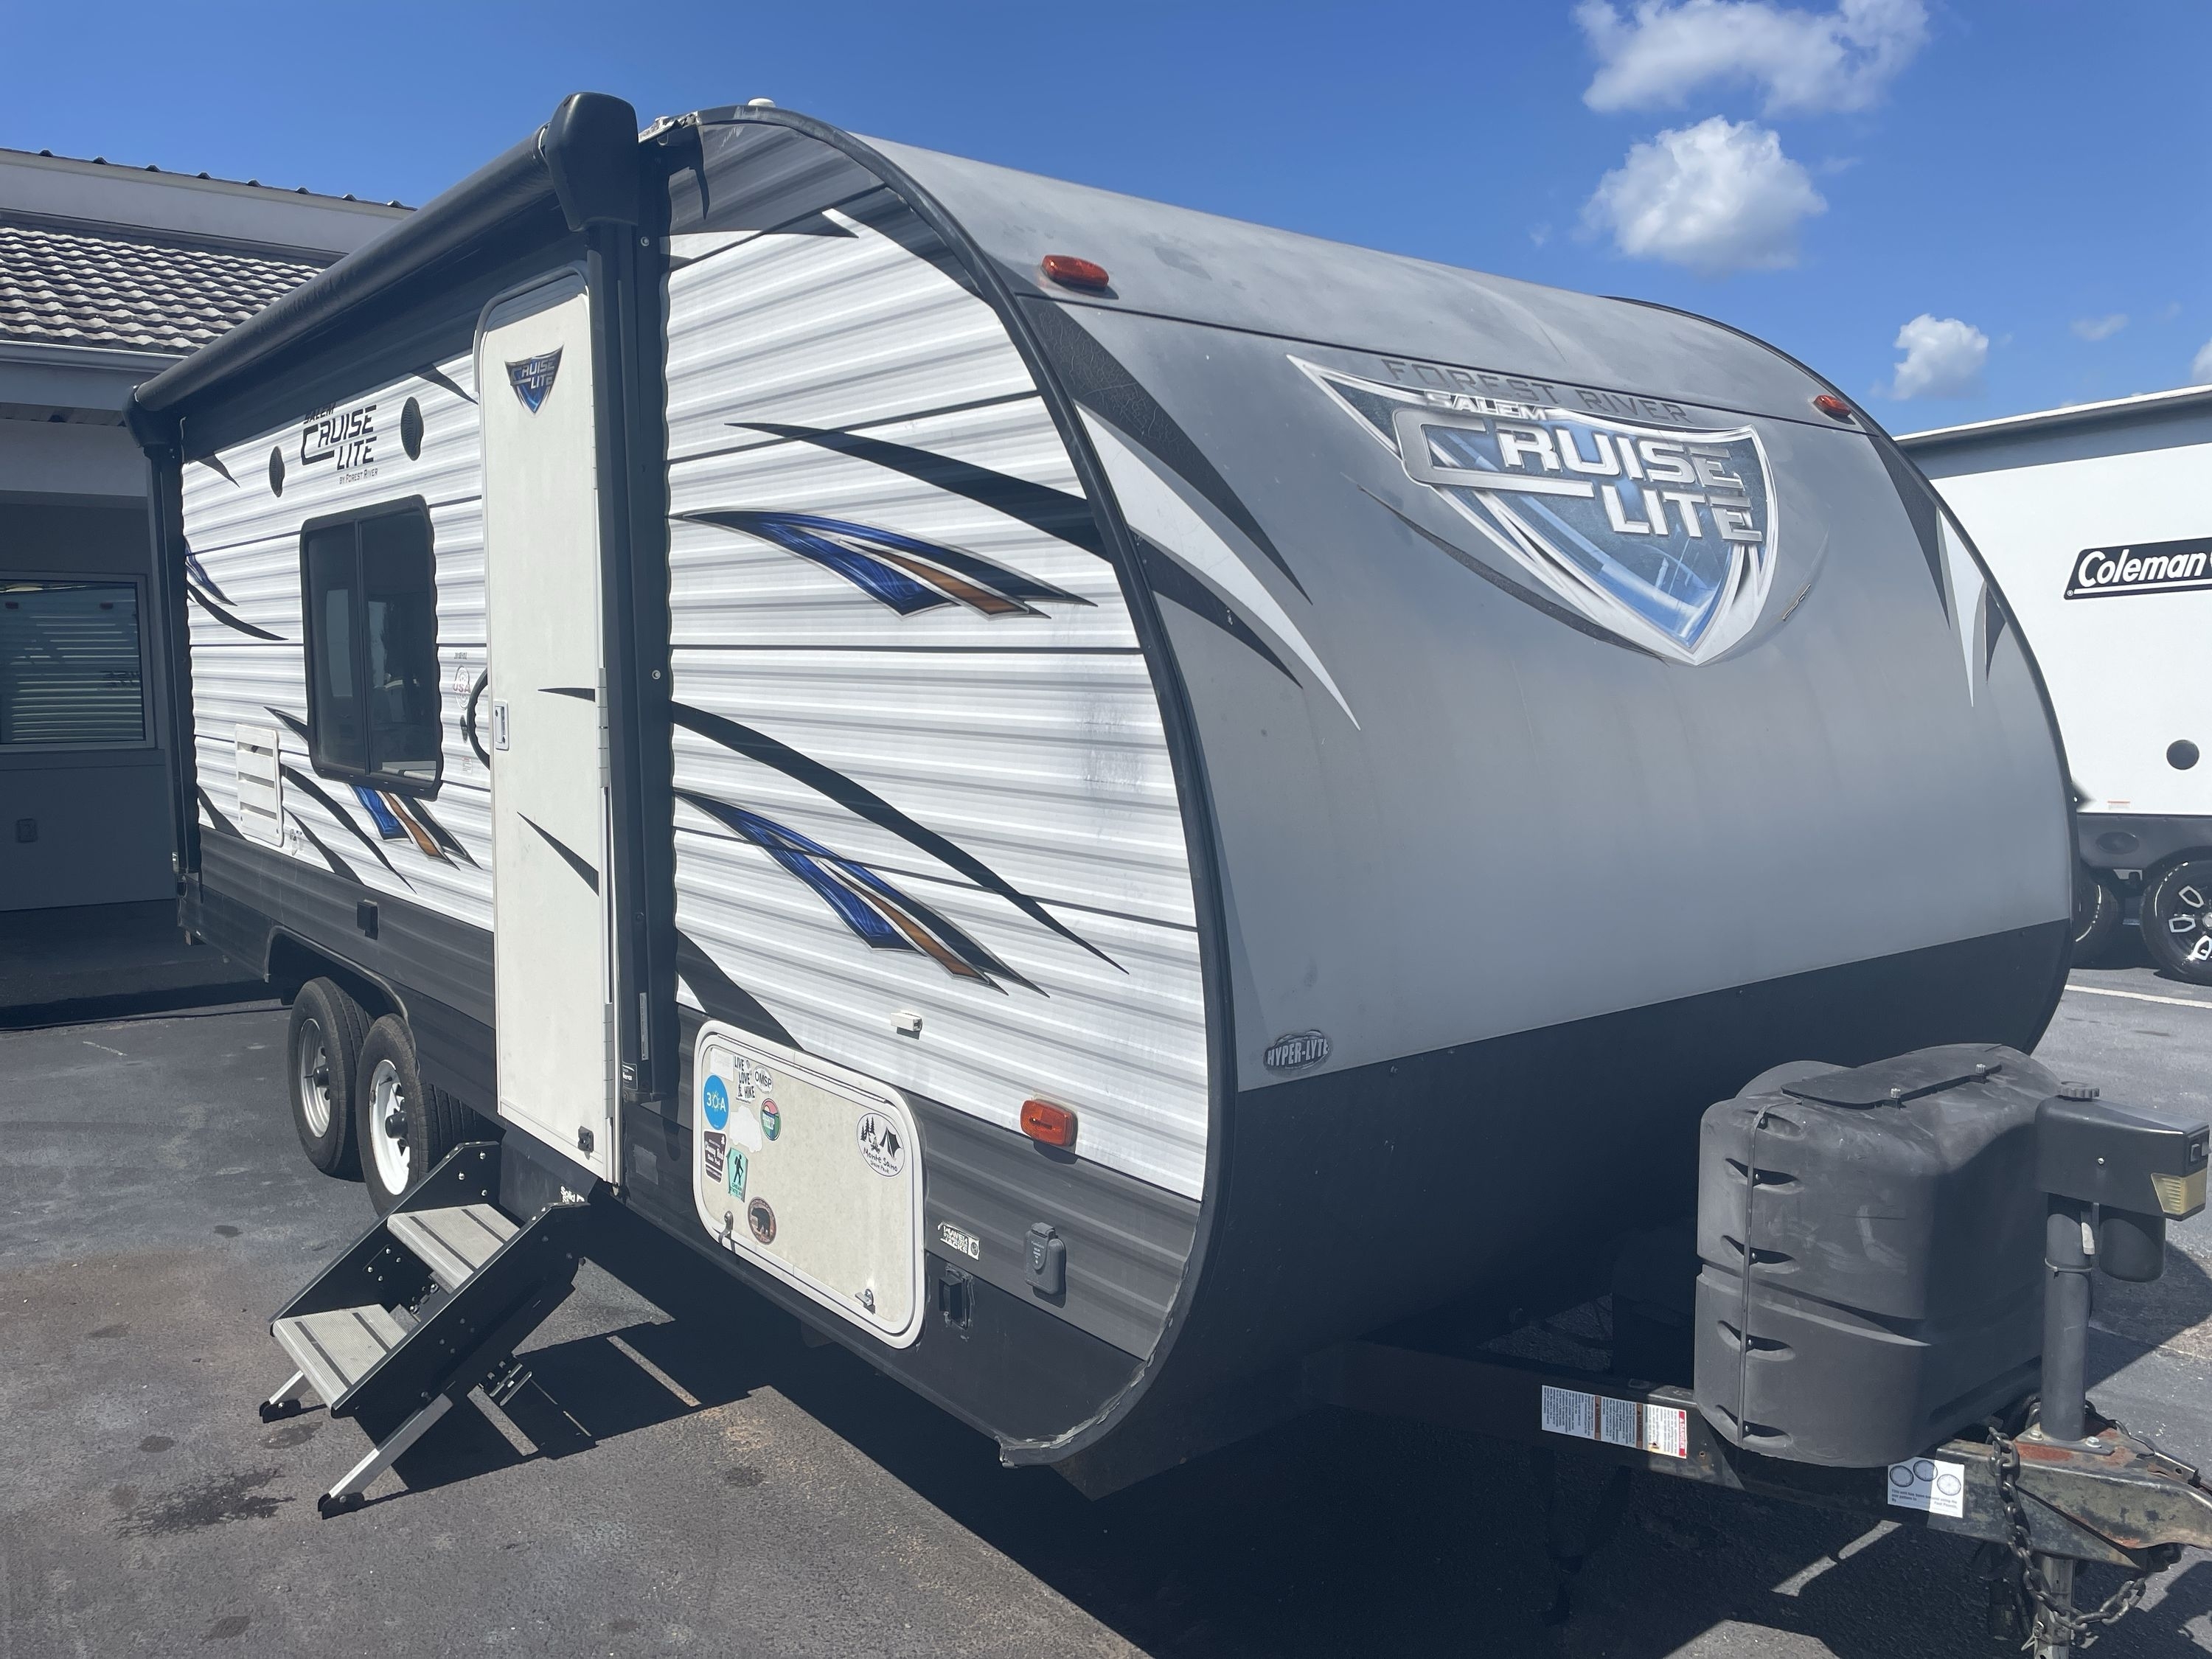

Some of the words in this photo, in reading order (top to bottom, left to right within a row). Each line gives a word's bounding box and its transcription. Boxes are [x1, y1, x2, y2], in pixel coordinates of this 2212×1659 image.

[510, 357, 556, 386] CRUISE
[530, 372, 554, 389] LITE
[1381, 358, 1559, 405] FOREST
[1576, 389, 1694, 425] RIVER
[1425, 389, 1548, 421] SALEM
[301, 405, 377, 466] CRUISE
[337, 436, 378, 470] LITE
[1394, 408, 1746, 498] CRUISE
[346, 472, 364, 483] FOREST
[364, 468, 378, 479] RIVER
[1600, 483, 1764, 546] LITE
[2078, 549, 2207, 588] Coleman
[453, 683, 471, 694] USA
[734, 1055, 745, 1072] LIVE
[738, 1071, 751, 1085] LOVE
[754, 1071, 773, 1089] OMSP
[744, 1085, 756, 1099] HIKE
[863, 1147, 882, 1164] Monte
[883, 1157, 898, 1172] Sano
